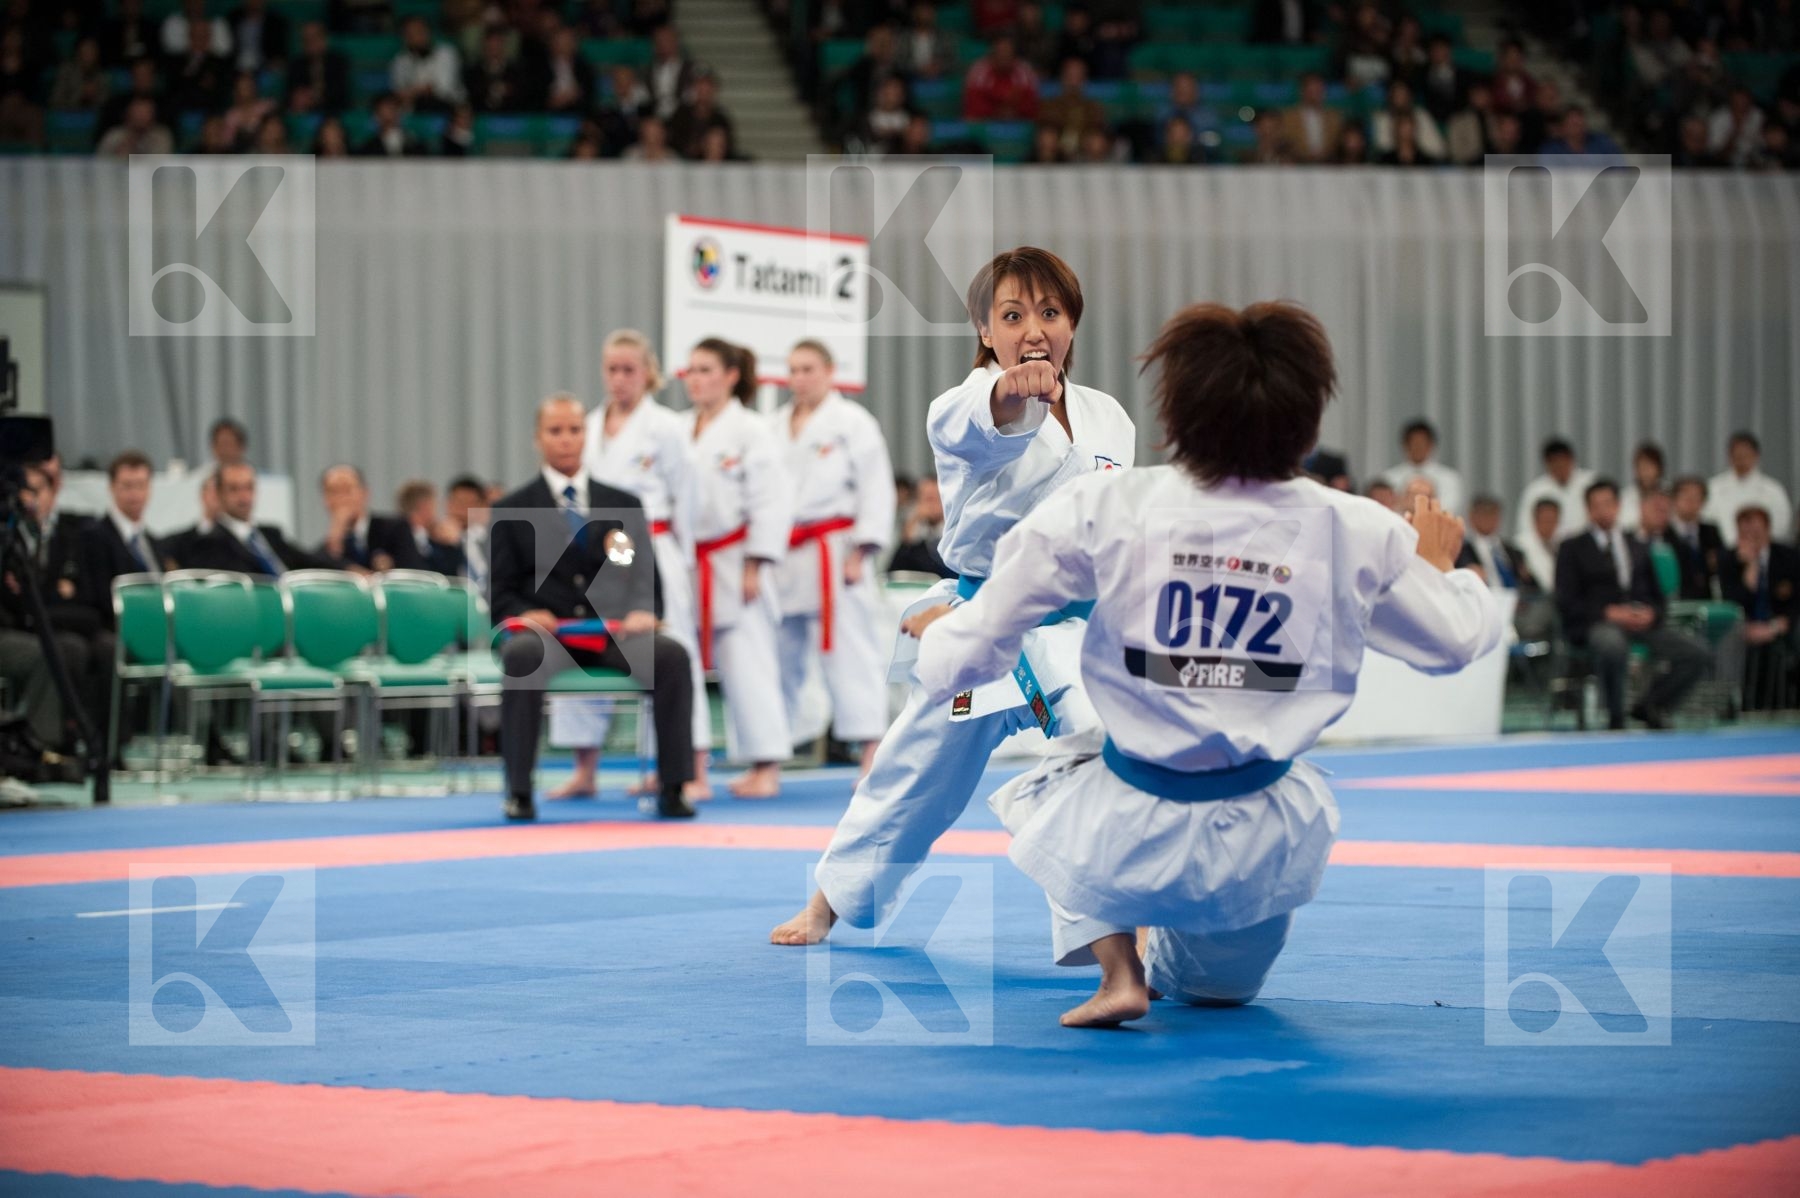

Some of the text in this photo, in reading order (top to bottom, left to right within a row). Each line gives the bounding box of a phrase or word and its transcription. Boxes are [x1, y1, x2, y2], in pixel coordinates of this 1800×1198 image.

[734, 254, 854, 299] Tatami 2
[1241, 559, 1270, 576] 東京
[1154, 580, 1293, 655] 0172
[1196, 664, 1246, 687] FIRE
